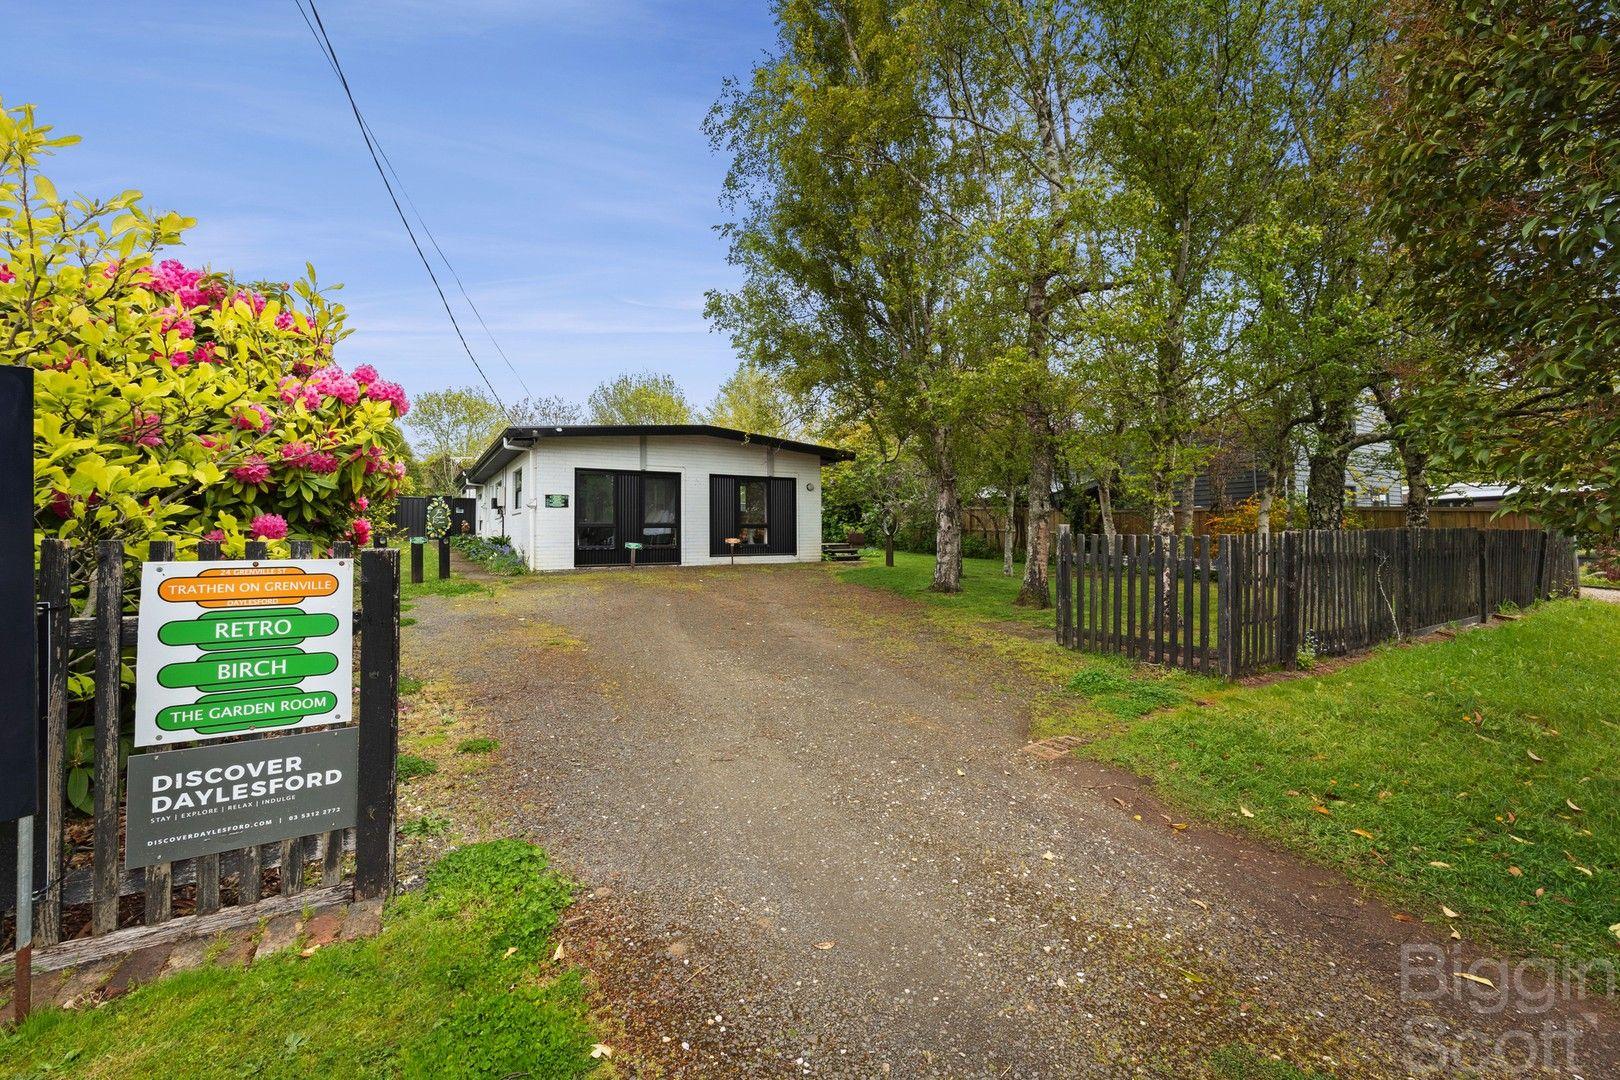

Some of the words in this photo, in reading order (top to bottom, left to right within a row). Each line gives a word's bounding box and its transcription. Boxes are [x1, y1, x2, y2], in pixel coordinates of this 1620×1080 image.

[233, 568, 274, 576] GRENVILLE
[168, 582, 235, 595] TRATHEN
[239, 582, 260, 593] ON
[264, 580, 332, 592] GRENVILLE
[226, 598, 279, 607] DAYLESFORD
[215, 619, 292, 639] RETRO
[217, 659, 287, 680] BIRCH
[170, 709, 203, 724] THE
[209, 702, 275, 719] GARDEN
[280, 696, 327, 711] ROOM
[151, 756, 302, 793] DISCOVER
[151, 769, 343, 814] DAYLESFORD
[150, 815, 171, 824] STAY
[181, 807, 219, 819] EXPLORE
[227, 801, 253, 811] RELAX
[261, 794, 296, 805] INDULGE
[147, 819, 273, 847] DISCOVERDAYLESFORD.COM
[288, 814, 299, 822] 03
[301, 811, 320, 819] 5312
